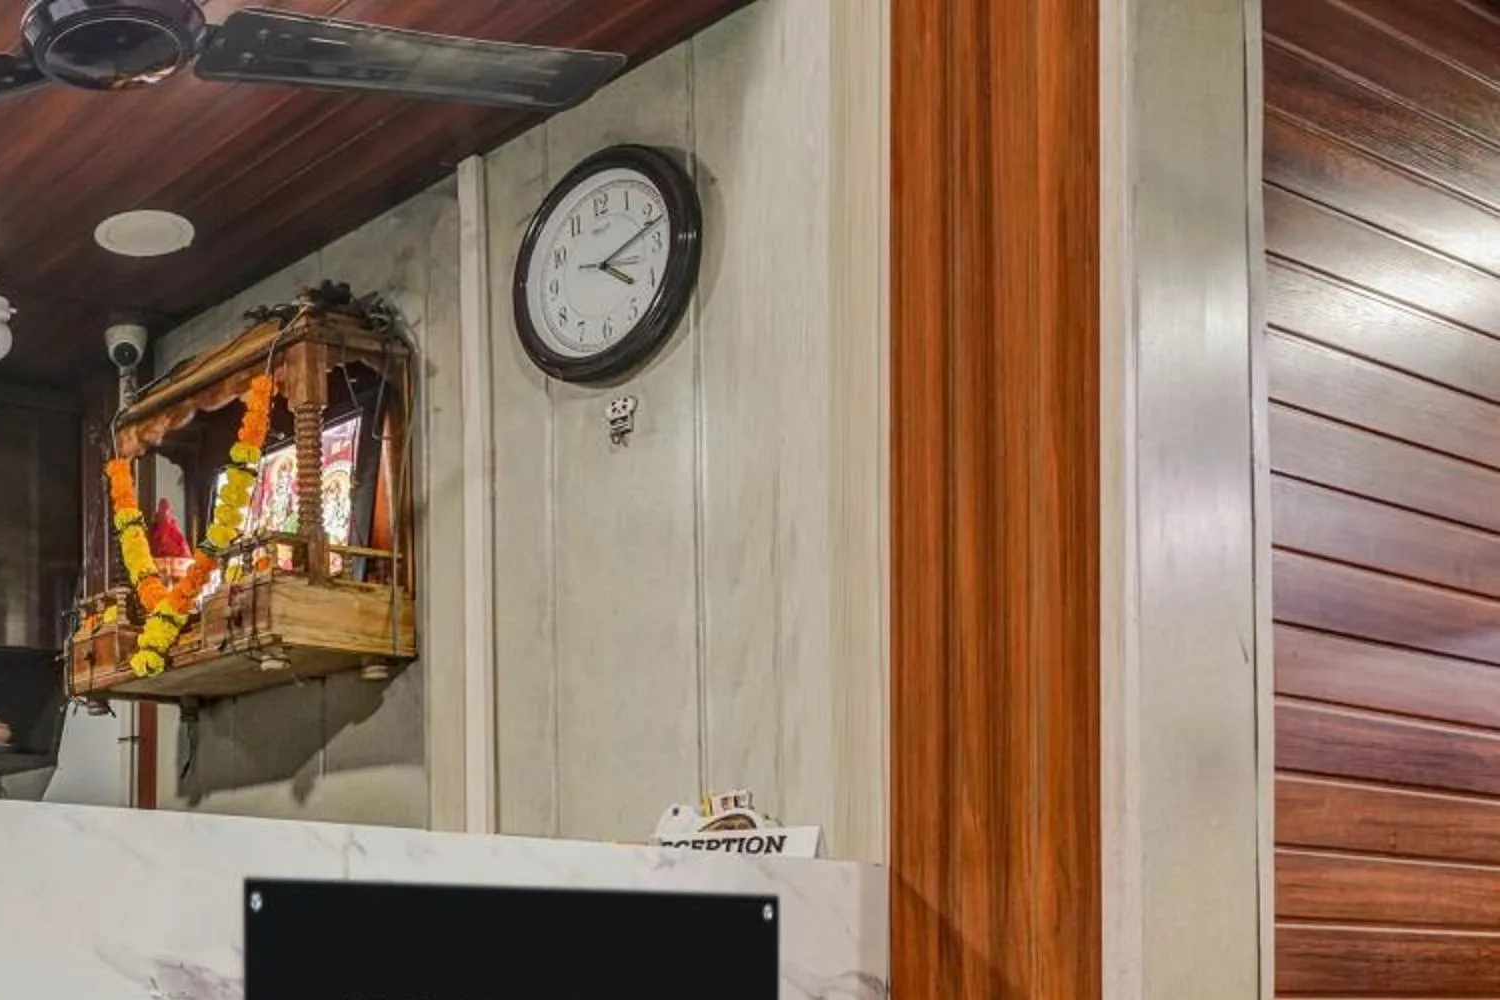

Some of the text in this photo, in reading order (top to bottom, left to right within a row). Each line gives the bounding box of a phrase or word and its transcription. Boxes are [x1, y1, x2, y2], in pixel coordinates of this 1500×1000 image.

[593, 192, 609, 217] 12
[624, 190, 630, 211] 1
[571, 215, 581, 237] 11
[652, 231, 663, 253] 3
[554, 245, 567, 269] 10
[550, 279, 559, 301] 9
[660, 835, 788, 855] EPTION
